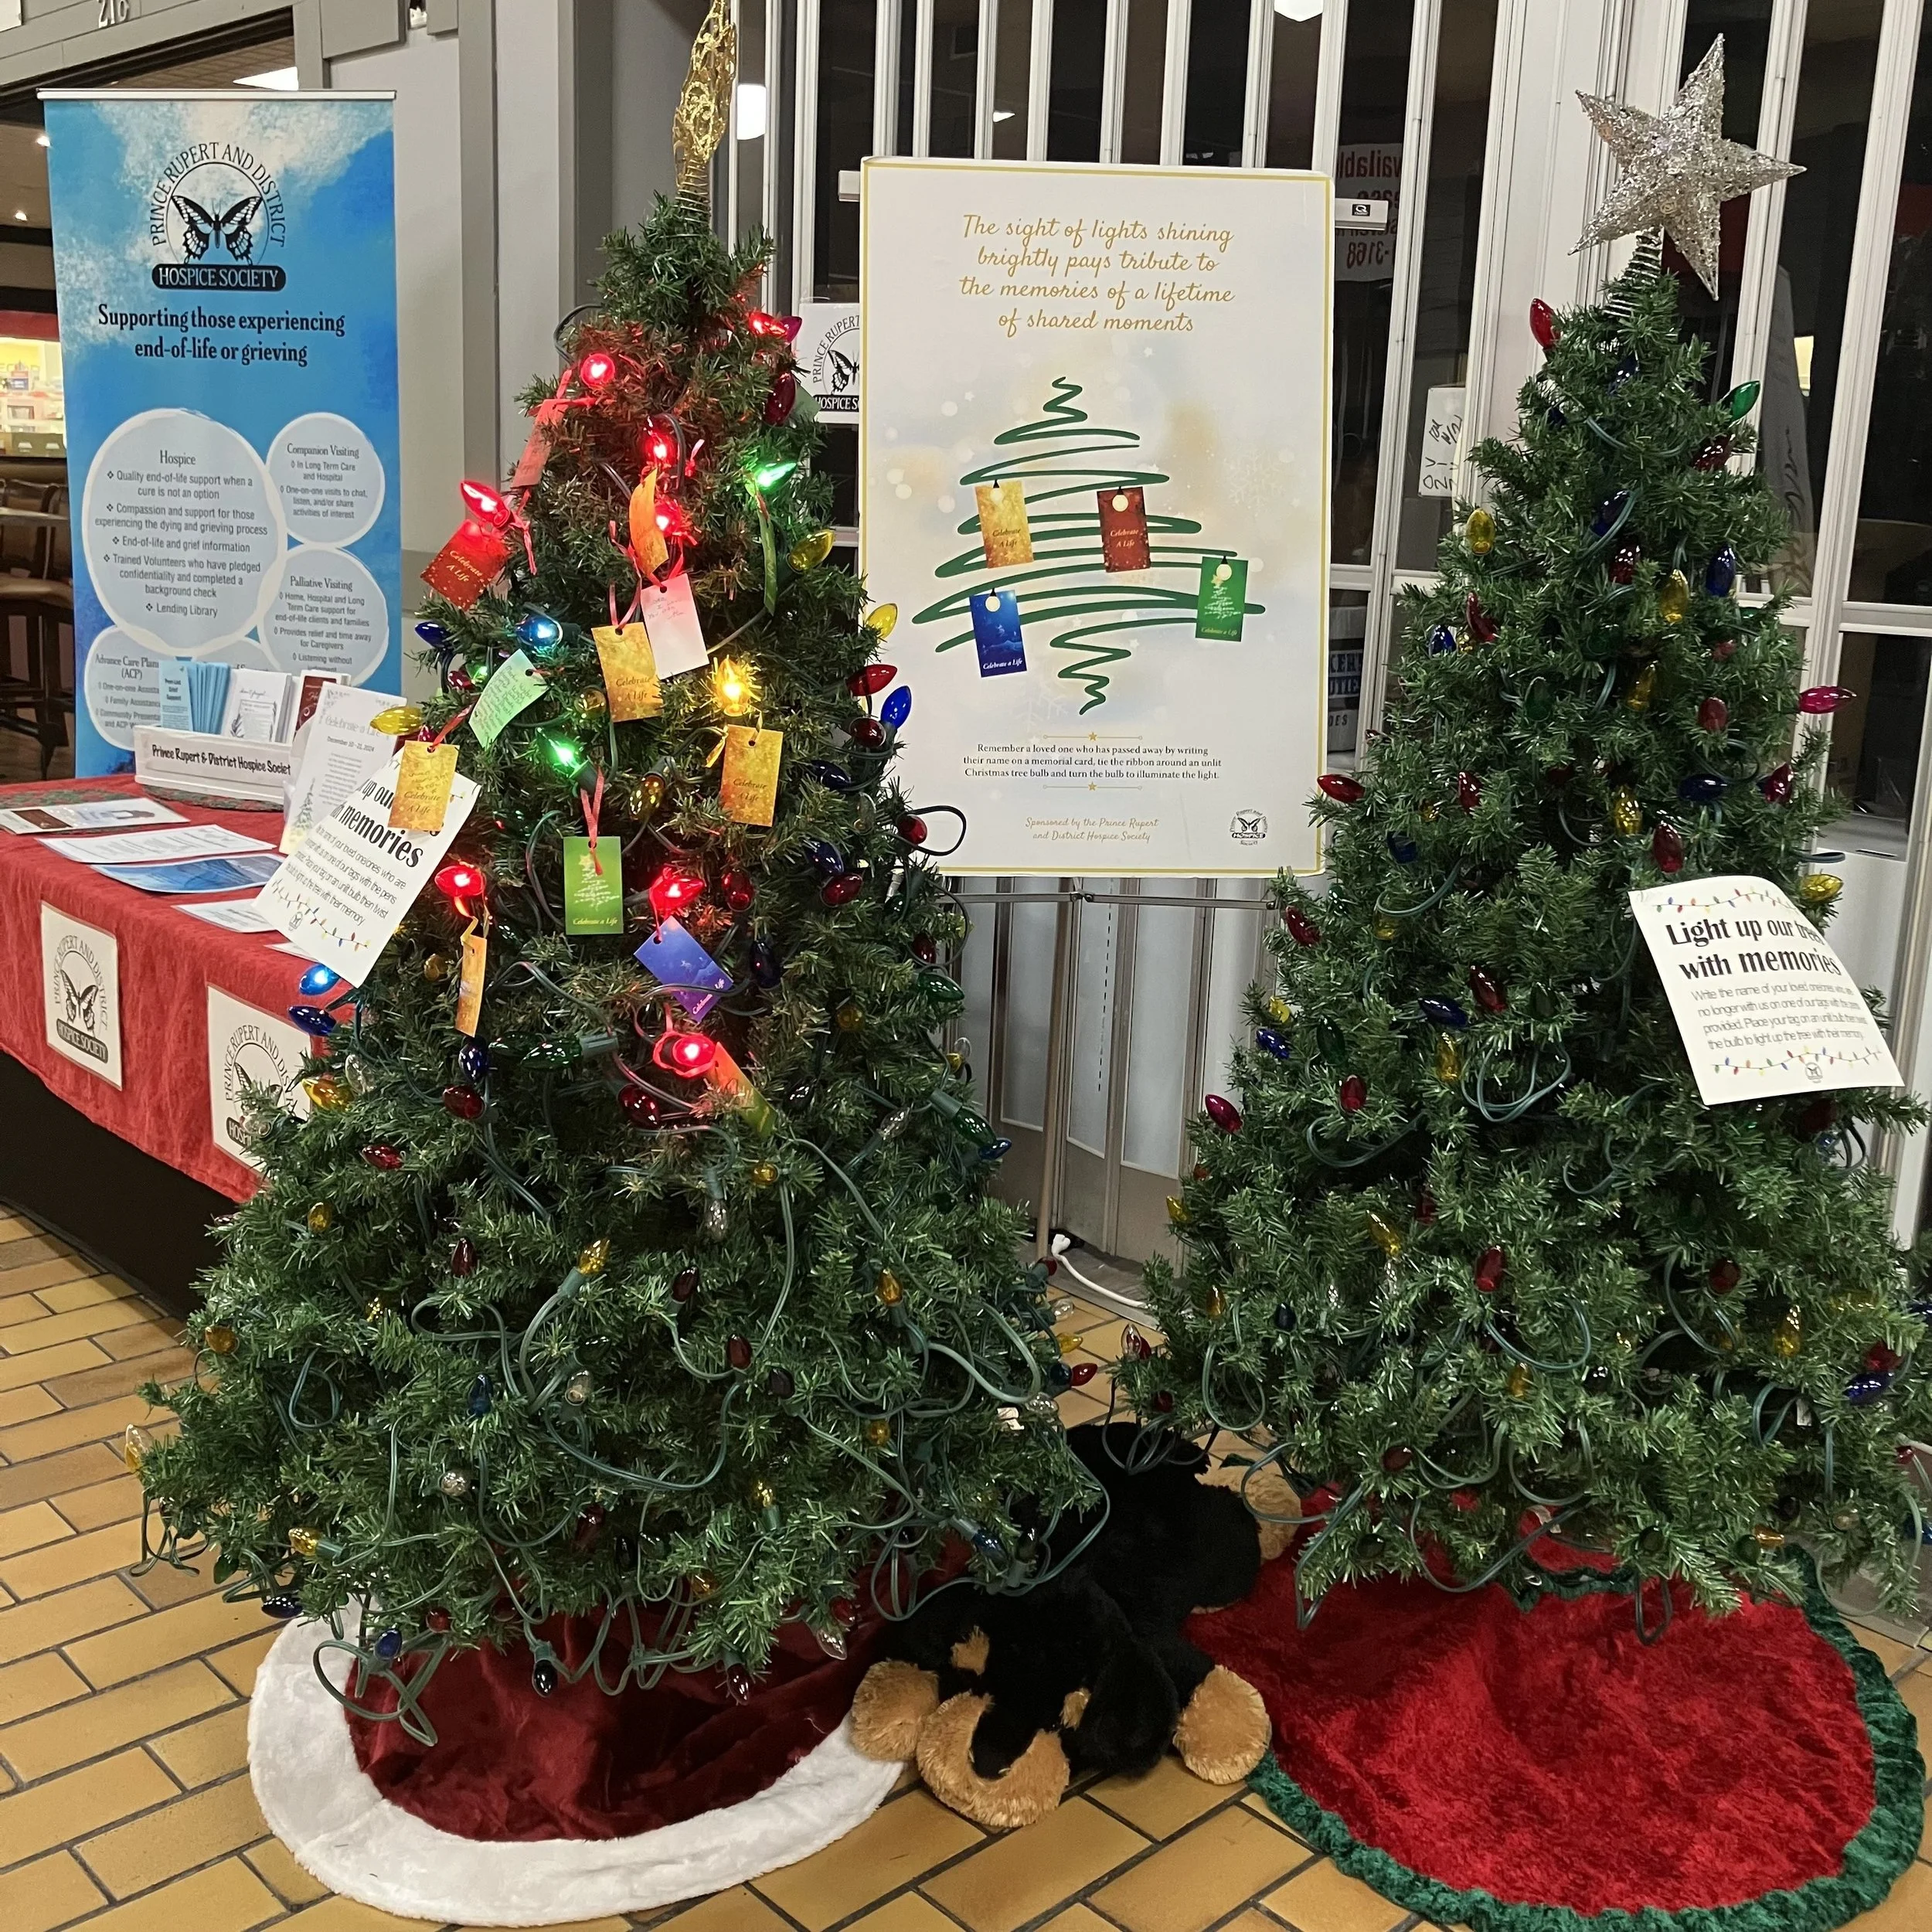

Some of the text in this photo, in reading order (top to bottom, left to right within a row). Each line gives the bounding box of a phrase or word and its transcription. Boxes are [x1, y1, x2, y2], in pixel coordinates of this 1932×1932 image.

[150, 142, 286, 247] PRINCE RUPERT AND DISTRICT
[964, 215, 1235, 253] The sight of lights shining
[978, 246, 1219, 277] brightly pays tribute to
[158, 267, 278, 287] HOSPICE SOCIETY
[959, 277, 1236, 311] the memories of a lifetime
[98, 304, 345, 337] Supporting those experiencing
[998, 308, 1193, 338] of shared moments
[134, 336, 308, 367] end-of-life or grieving
[813, 315, 859, 383] PRINCE RUPERT
[159, 450, 196, 468] Hospice
[287, 443, 359, 459] Companion Visiting
[117, 471, 145, 483] Quality
[147, 473, 187, 483] end-of-life
[189, 474, 221, 486] support
[223, 476, 246, 486] when
[138, 487, 155, 496] cure
[158, 487, 165, 497] is
[167, 488, 180, 498] not
[194, 488, 219, 501] option
[117, 503, 255, 520] Compassion and support for those
[95, 517, 268, 536] experiencing the dying and grieving process
[993, 529, 1021, 537] Celebrate
[1111, 529, 1140, 537] Celebrate
[123, 536, 250, 552] End-of-life and grief information
[1005, 539, 1017, 548] Life
[113, 553, 260, 573] Trained Volunteers who have pledged
[450, 550, 483, 577] Celebrate
[120, 569, 175, 582] confidentiality
[177, 571, 191, 582] and
[193, 573, 236, 585] completed
[291, 576, 353, 592] Palliative Visiting
[454, 570, 470, 582] Life
[145, 584, 216, 597] background check
[156, 603, 218, 618] Lending Library
[983, 661, 1006, 670] Celebrate
[1012, 658, 1023, 666] Life
[616, 676, 651, 687] Celebrate
[634, 691, 648, 701] Life
[978, 743, 1025, 753] Remember
[1033, 743, 1056, 753] loved
[1076, 745, 1094, 753] who
[1096, 746, 1111, 754] has
[1112, 746, 1141, 757] passed
[1142, 747, 1163, 757] away
[1165, 746, 1175, 757] by
[1177, 747, 1208, 757] writing
[151, 744, 292, 776] Prince Rupert & District Hospice Societ
[963, 756, 985, 765] their
[1031, 757, 1072, 766] memorial
[1074, 757, 1096, 767] card,
[1097, 757, 1108, 766] tie
[1111, 757, 1124, 766] the
[1126, 758, 1154, 767] ribbon
[1156, 758, 1187, 767] around
[1201, 758, 1221, 767] unlit
[964, 767, 1009, 777] Christmas
[1030, 768, 1049, 777] bulb
[1051, 769, 1067, 778] and
[1069, 770, 1087, 778] turn
[1090, 769, 1103, 778] the
[1105, 769, 1124, 778] bulb
[1126, 770, 1134, 778] to
[1137, 769, 1180, 779] illuminate
[1182, 770, 1196, 779] the
[1198, 769, 1219, 781] light.
[1026, 817, 1159, 829] Sponsored by the Prince Rupert
[338, 804, 423, 867] memories
[1032, 831, 1150, 844] and District Hospice Society
[1665, 919, 1731, 947] Light
[1735, 920, 1763, 941] up
[1767, 920, 1794, 937] our
[1679, 947, 1842, 980] with memories
[224, 1024, 279, 1101] PRINCE RUPERT AND
